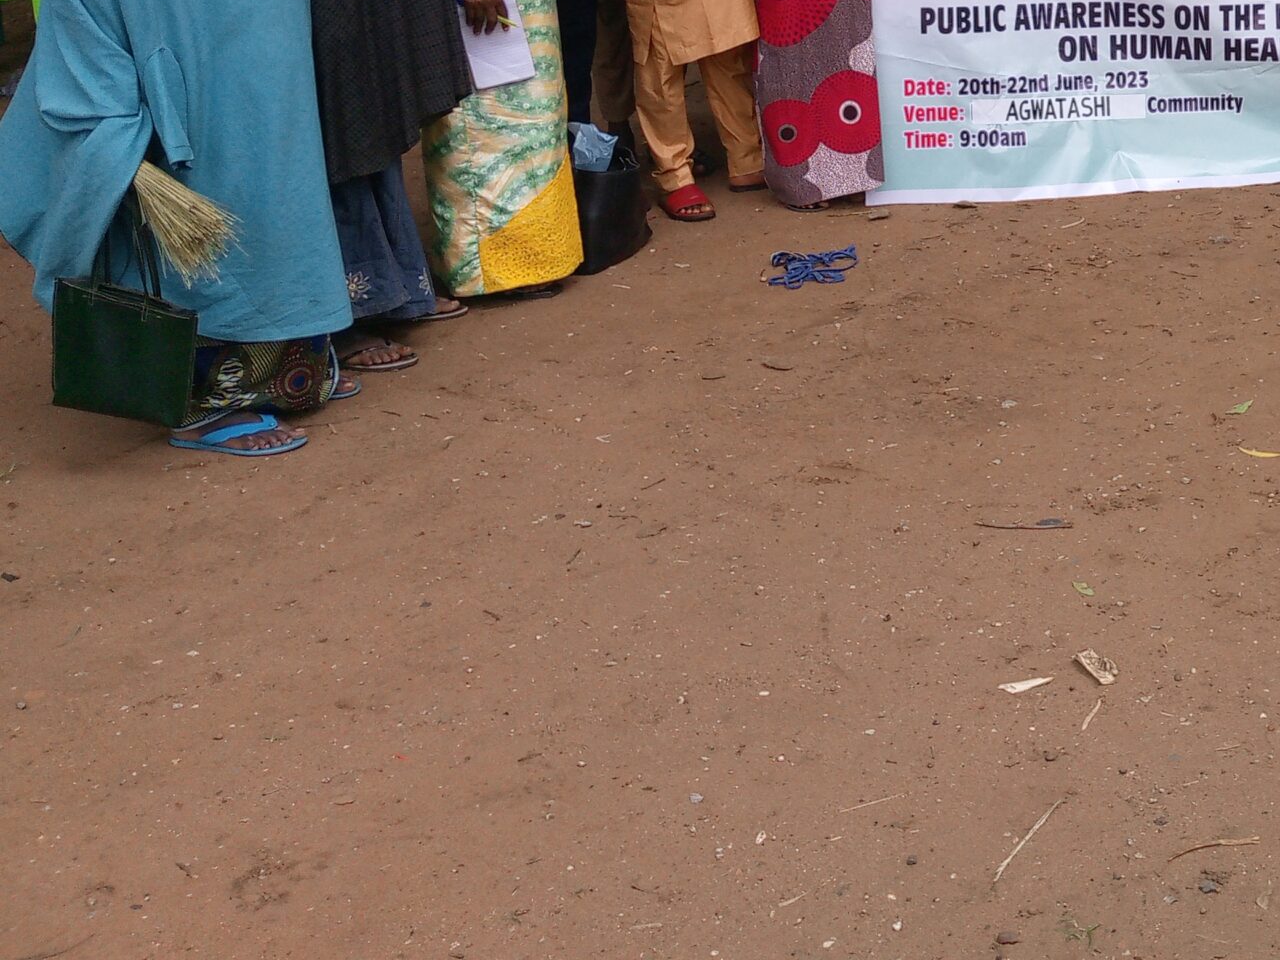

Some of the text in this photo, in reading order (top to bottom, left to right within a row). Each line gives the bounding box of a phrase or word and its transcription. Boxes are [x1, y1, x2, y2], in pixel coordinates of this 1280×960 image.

[920, 4, 1007, 34] PUBLIC
[1014, 2, 1165, 31] AWARENESS
[1174, 5, 1210, 31] ON
[1219, 4, 1266, 31] THE
[1058, 35, 1098, 63] ON
[1110, 35, 1212, 62] HUMAN
[903, 71, 1149, 97] Date: 20th-22nd June, 2023
[903, 94, 1244, 123] Venue: AGWATASHI Community
[903, 129, 1027, 149] Time: 9:00am
